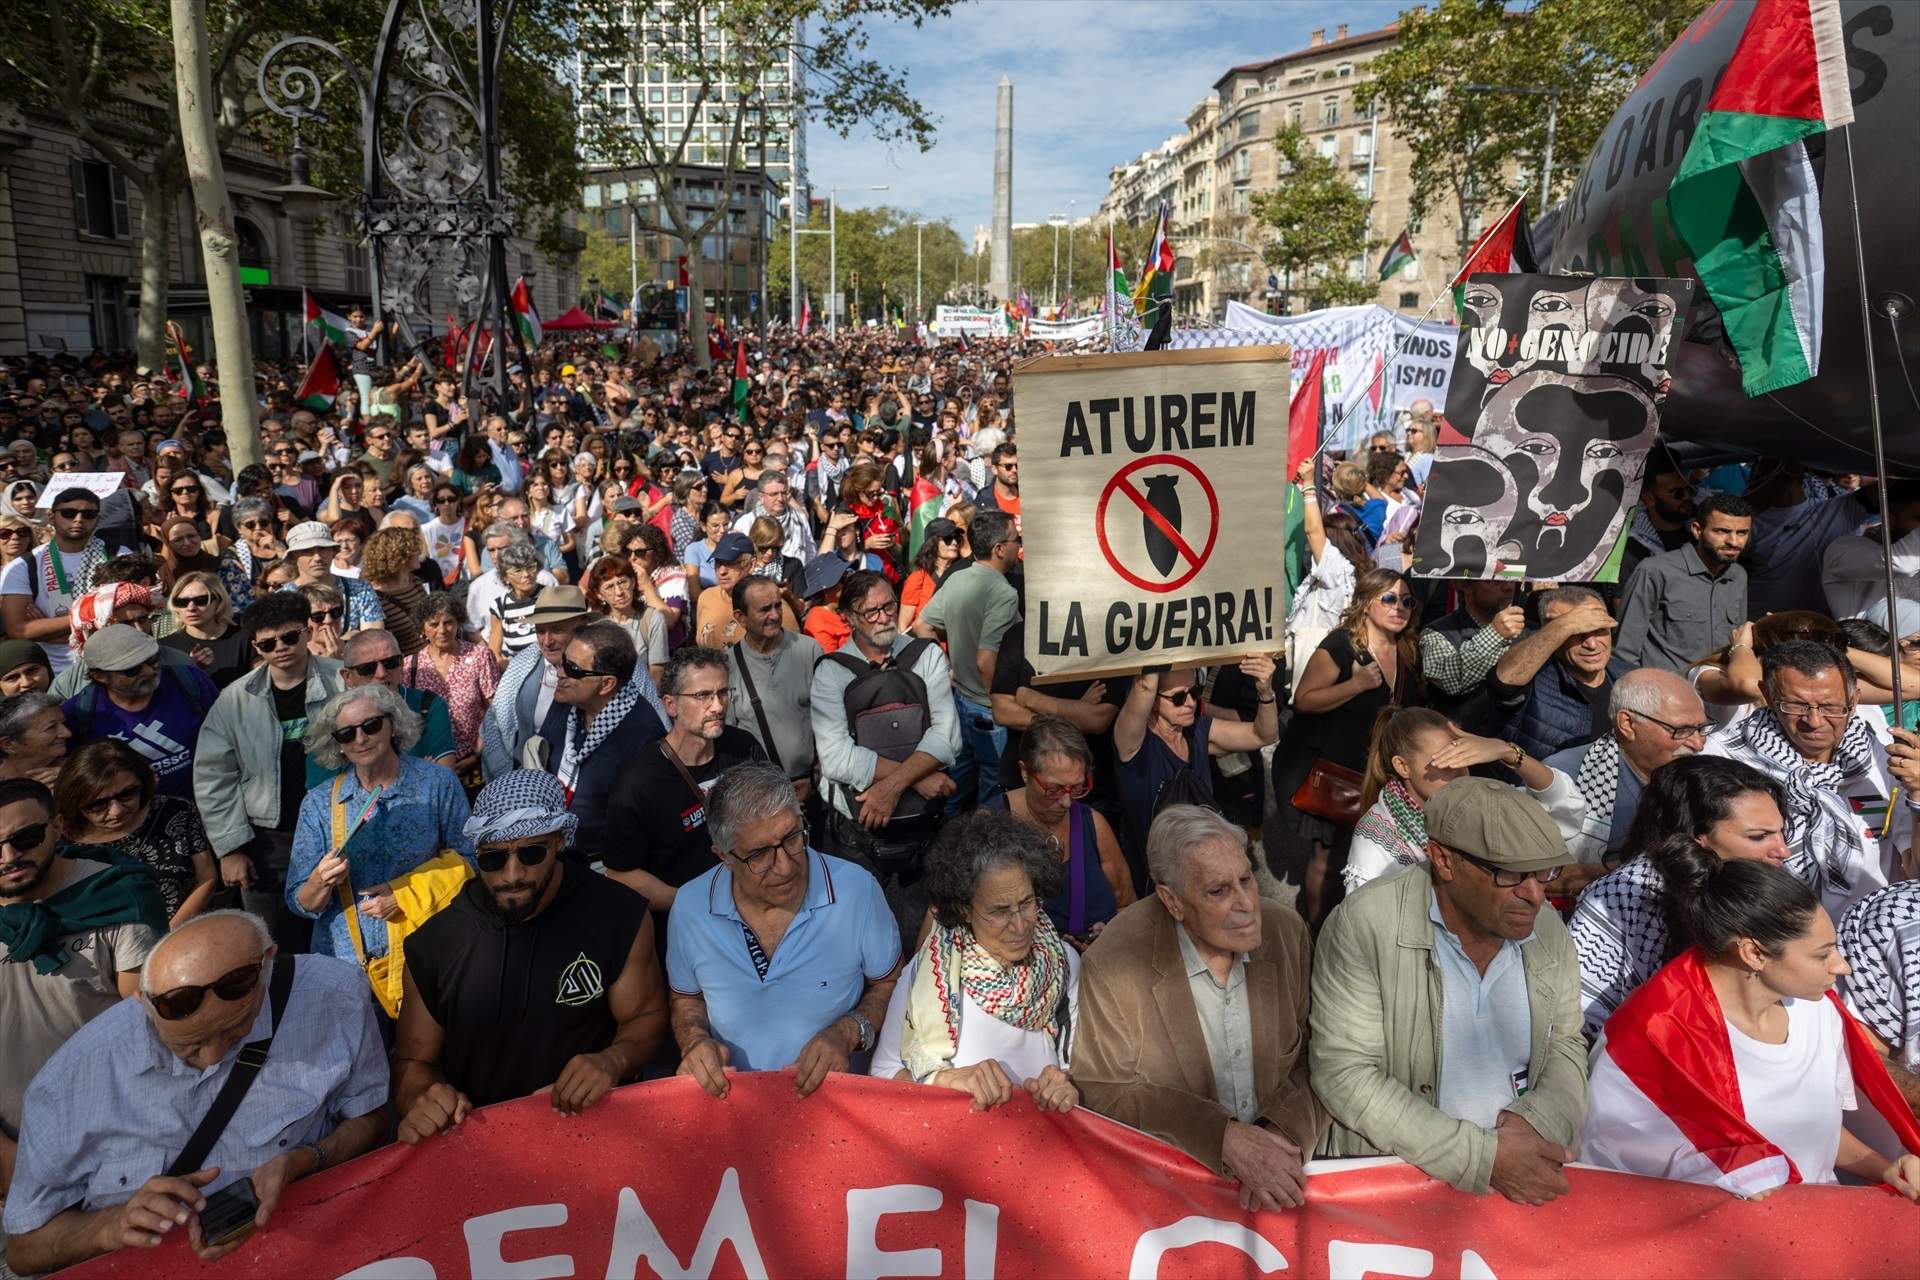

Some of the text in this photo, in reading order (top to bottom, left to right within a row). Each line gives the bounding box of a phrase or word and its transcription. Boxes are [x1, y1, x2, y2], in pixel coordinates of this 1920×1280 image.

[1466, 327, 1508, 360] NO
[1520, 331, 1671, 365] GENOCIDE
[1060, 391, 1257, 457] ATUREM
[1039, 587, 1273, 657] LA GUERRA!
